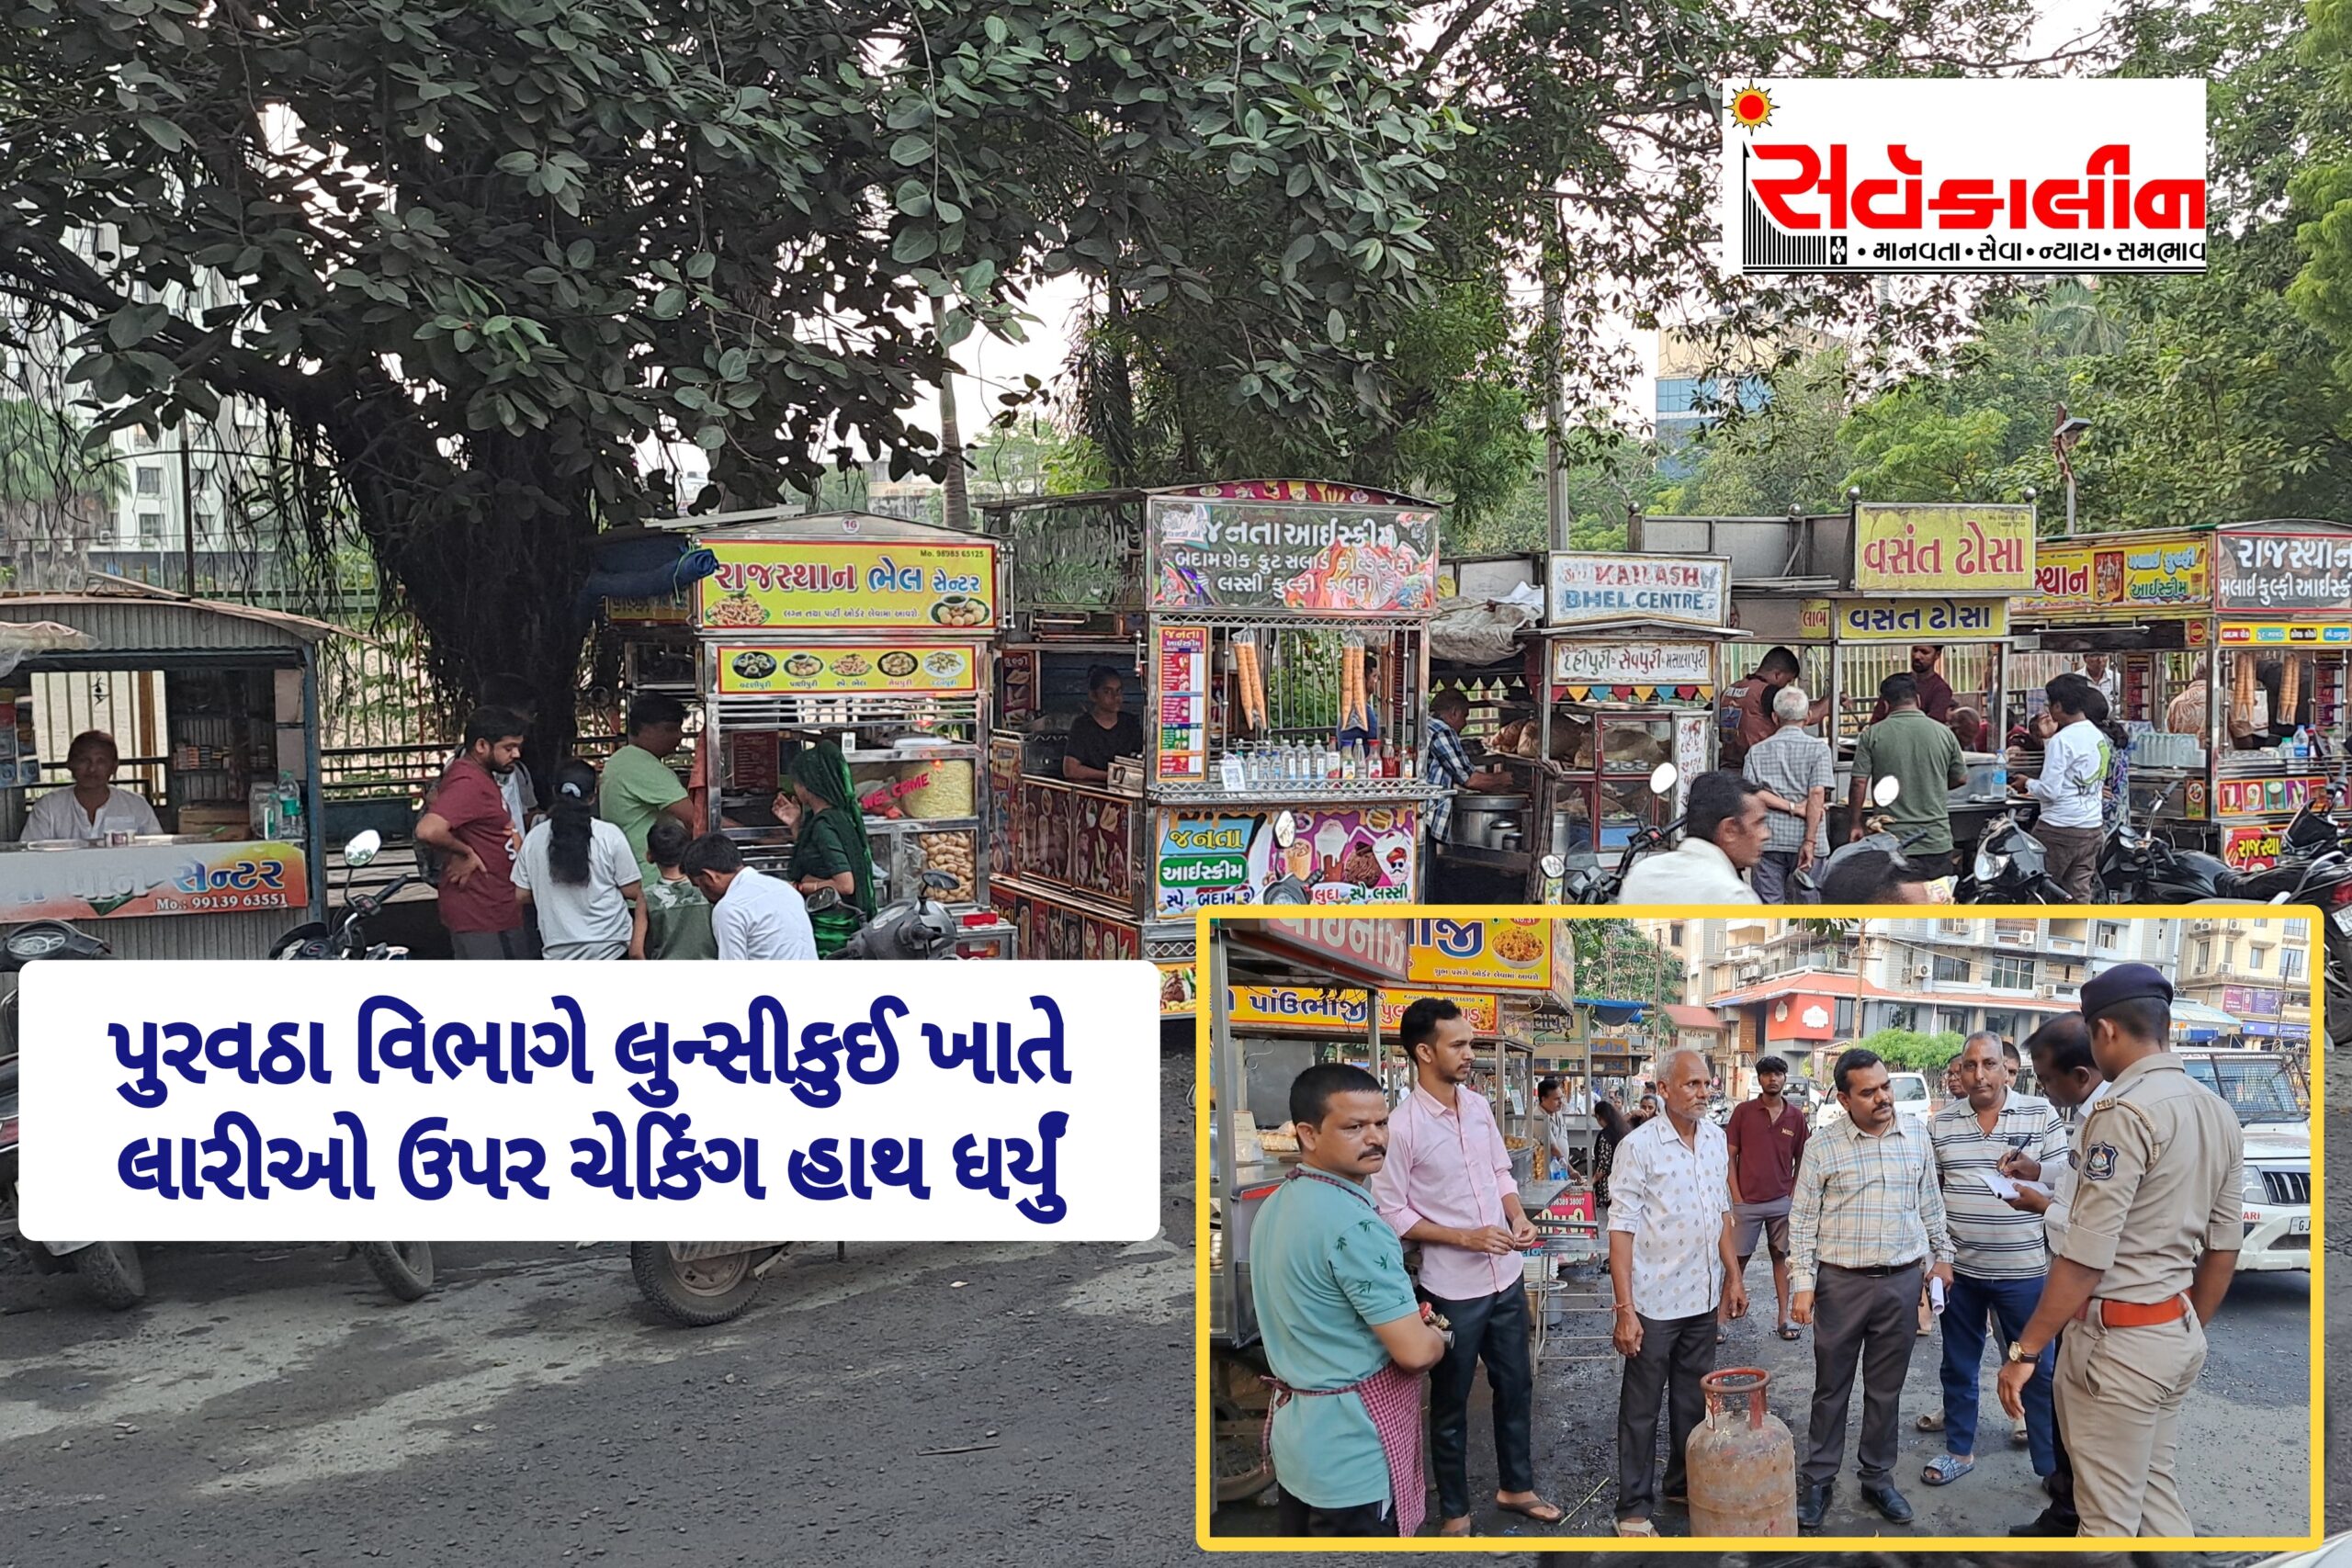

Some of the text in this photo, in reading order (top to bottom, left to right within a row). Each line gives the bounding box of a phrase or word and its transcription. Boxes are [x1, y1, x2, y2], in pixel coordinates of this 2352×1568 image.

[1202, 520, 1281, 545] જનતા
[1863, 521, 2026, 575] વસંત ઢોસા
[714, 557, 981, 593] રાજસ્થાન ભેલ સેન્ટર
[1565, 590, 1704, 610] BHEL CENTRE
[1849, 598, 1991, 631] વસંત ઢોસા
[1164, 630, 1200, 639] જનતા
[1169, 829, 1246, 850] જનતા
[2237, 837, 2280, 859] રાજસ્થા
[191, 897, 238, 909] 99139
[243, 893, 288, 907] 63551
[1372, 881, 1409, 900] લસ્સી
[1250, 987, 1369, 1023] પાંઉભાજી
